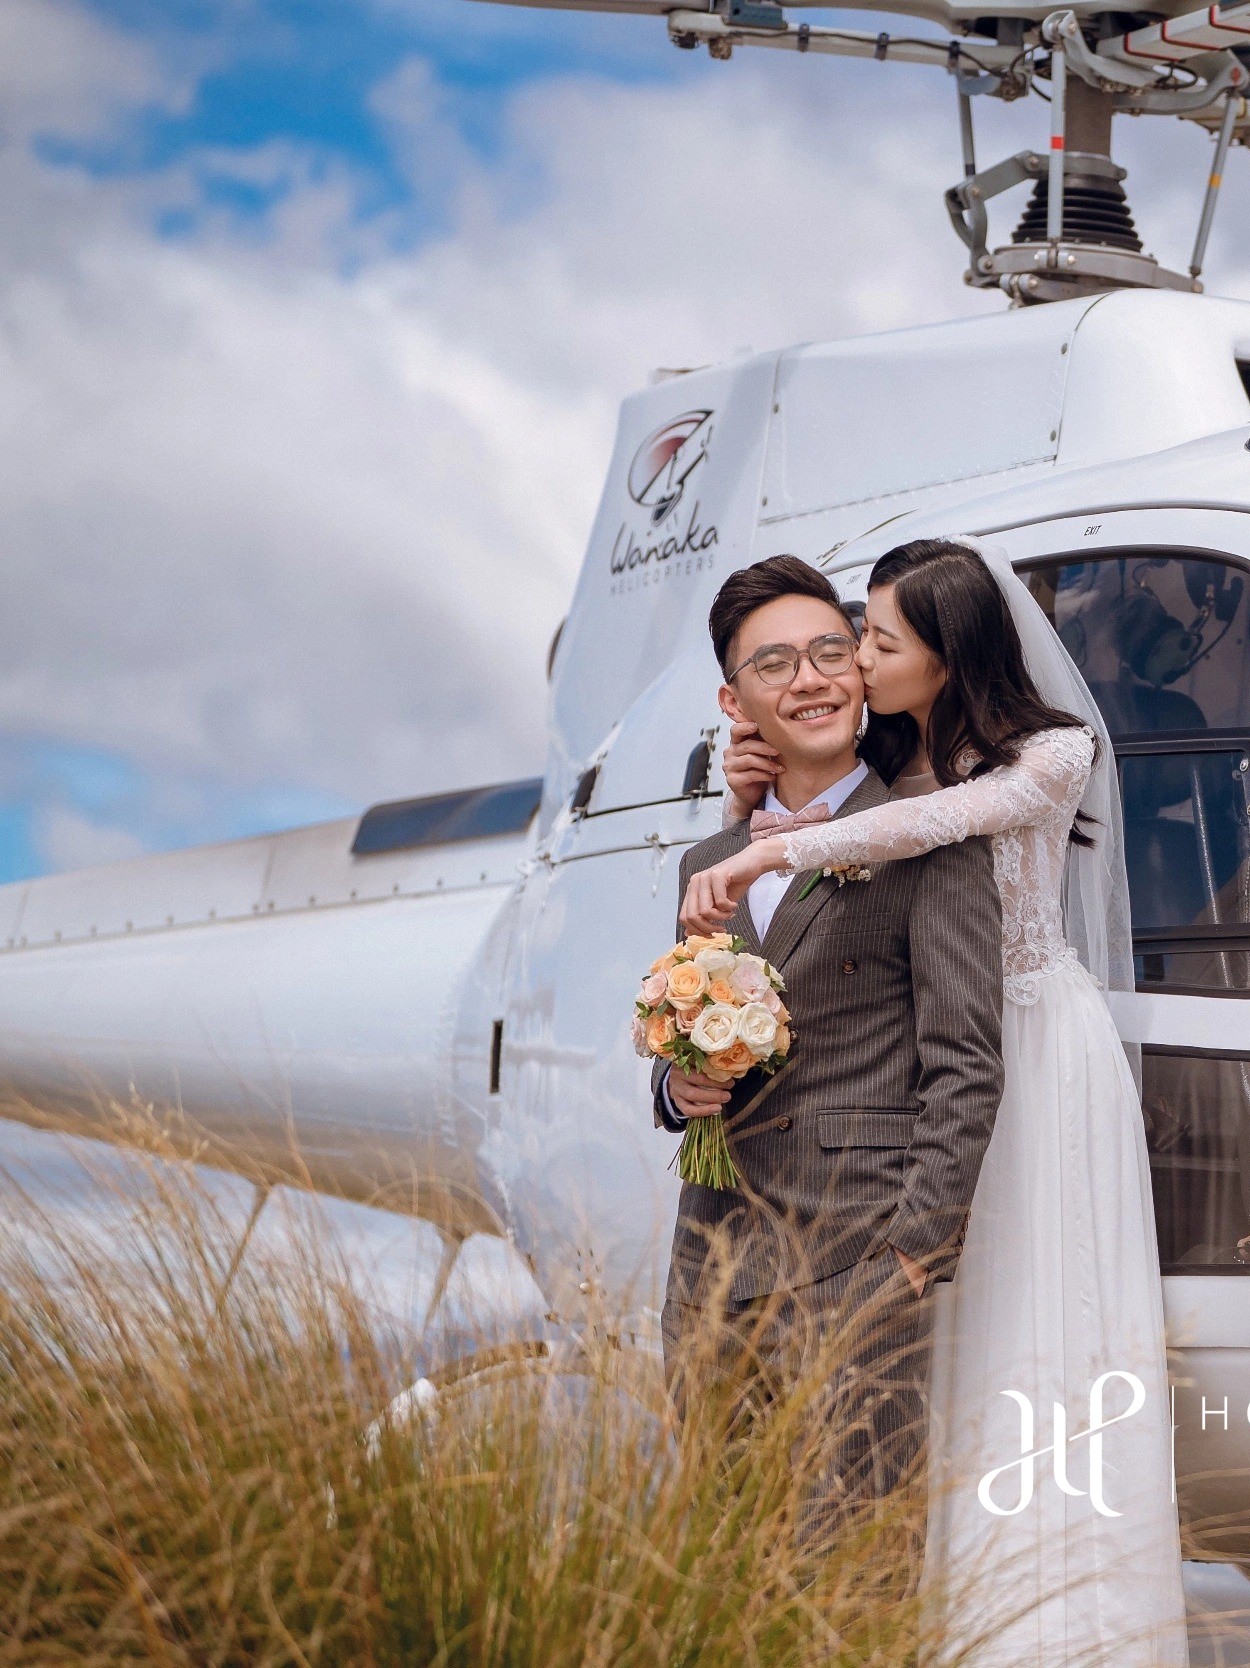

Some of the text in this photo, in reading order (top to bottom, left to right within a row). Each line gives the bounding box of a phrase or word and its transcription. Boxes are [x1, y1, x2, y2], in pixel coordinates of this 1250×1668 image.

[610, 500, 719, 575] Wanaka
[1084, 525, 1102, 536] EXIT
[610, 553, 714, 595] HELICOPTERS
